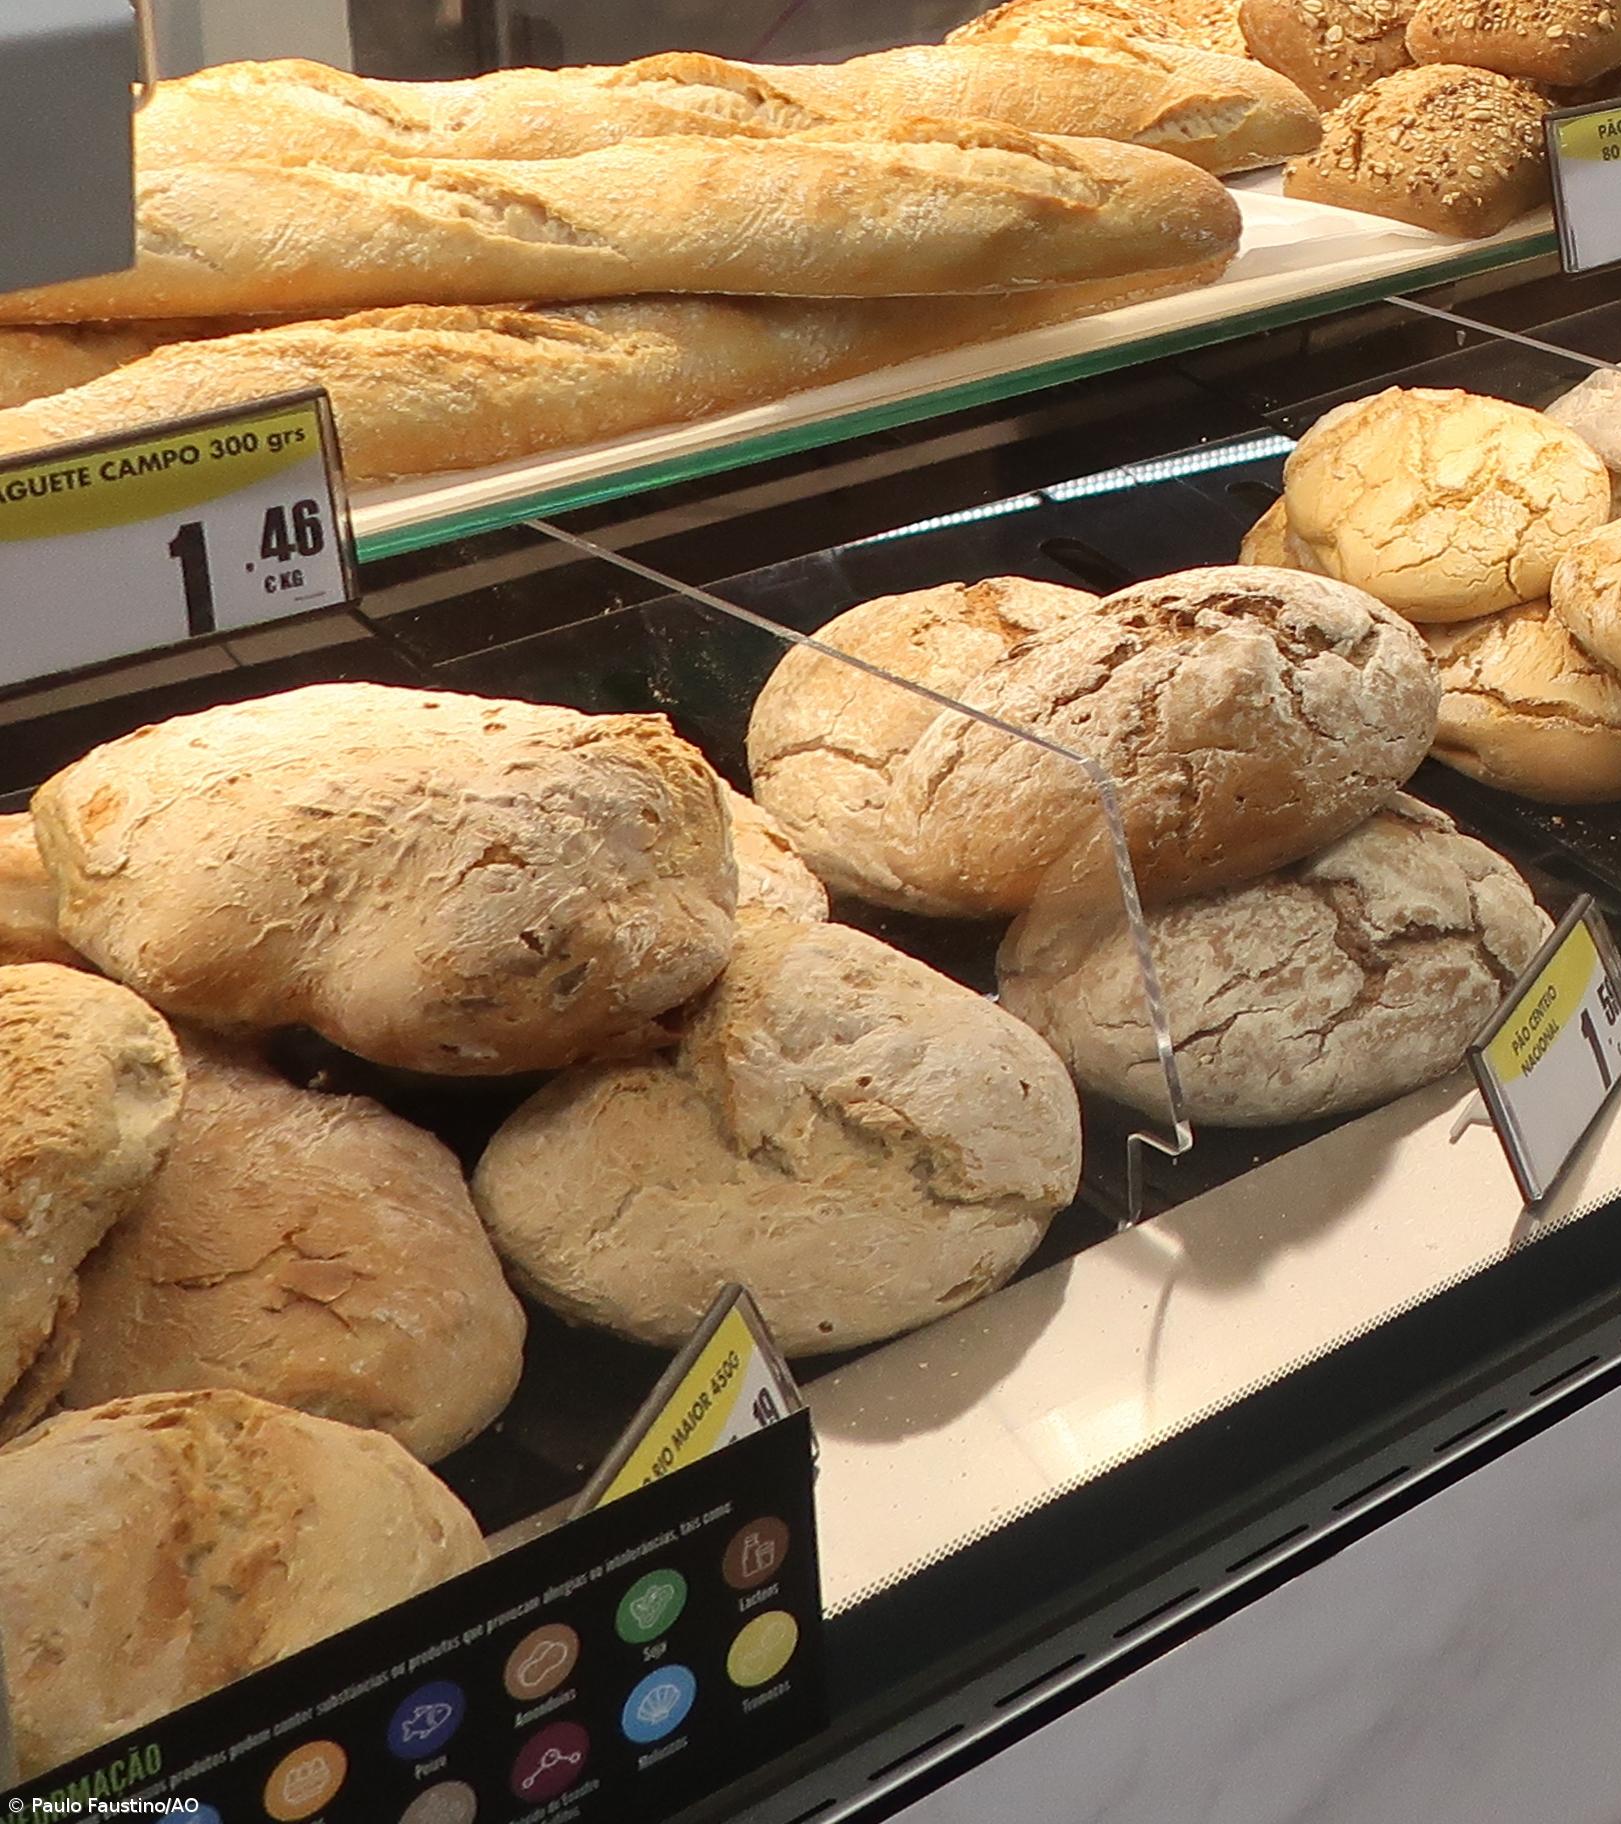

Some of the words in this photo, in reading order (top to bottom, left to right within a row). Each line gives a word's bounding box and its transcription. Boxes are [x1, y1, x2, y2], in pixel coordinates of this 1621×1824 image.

[1601, 145, 1621, 162] 80
[0, 466, 93, 506] GUETE
[100, 443, 201, 482] CAMPO
[209, 432, 259, 461] 300
[266, 426, 307, 454] grs
[280, 569, 305, 591] KG
[1511, 1025, 1531, 1057] PÃO
[1528, 984, 1557, 1031] CENTEIO
[1520, 1018, 1560, 1078] NACIONAL
[651, 1446, 675, 1480] RIO
[671, 1391, 713, 1453] MAIOR
[709, 1349, 740, 1397] 450G
